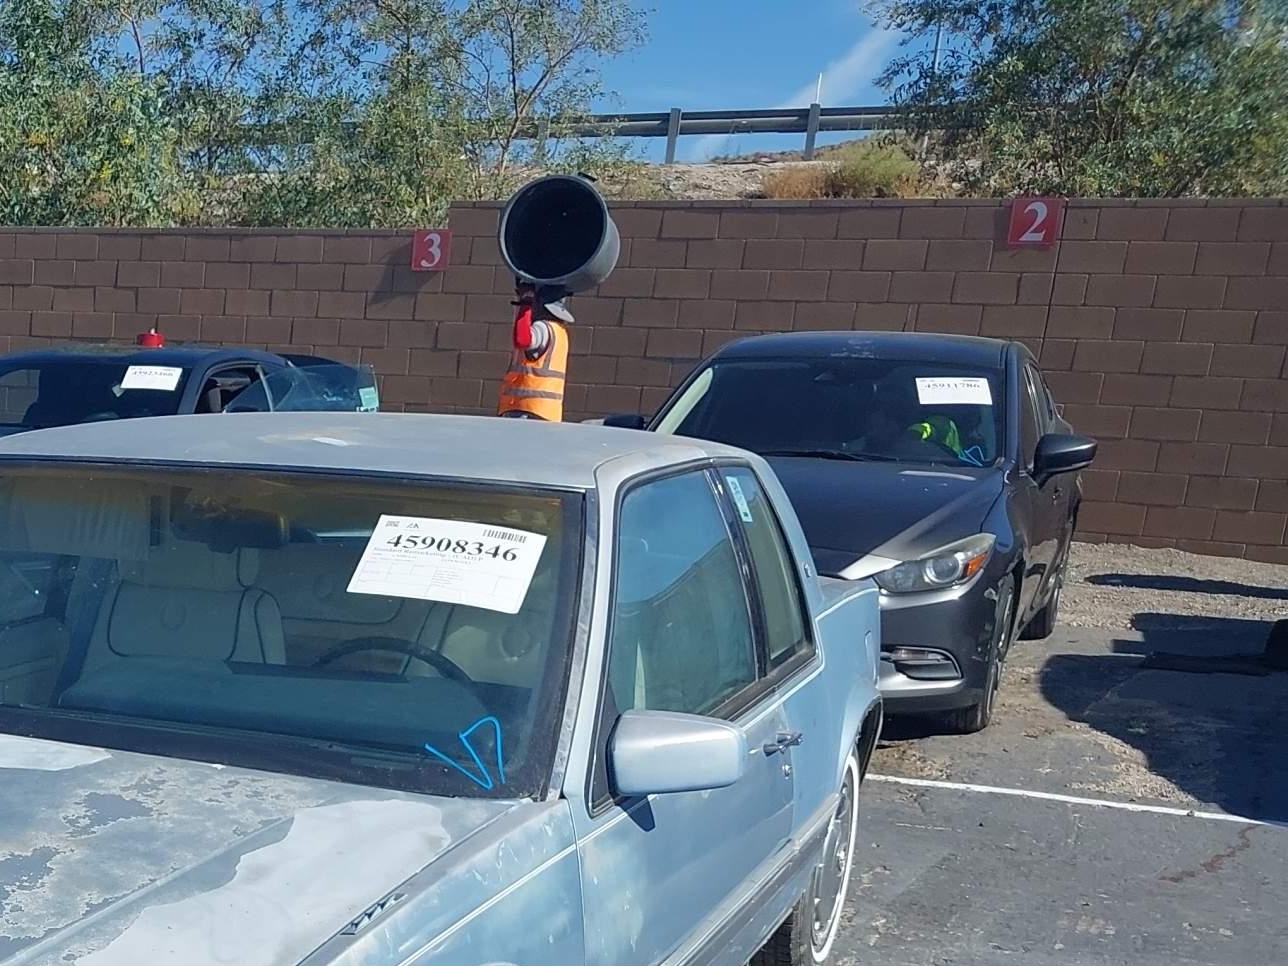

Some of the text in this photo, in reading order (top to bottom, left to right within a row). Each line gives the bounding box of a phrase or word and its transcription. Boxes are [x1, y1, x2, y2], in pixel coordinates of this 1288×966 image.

[1018, 201, 1048, 241] 2
[420, 232, 441, 267] 3
[386, 534, 521, 562] 45908346
